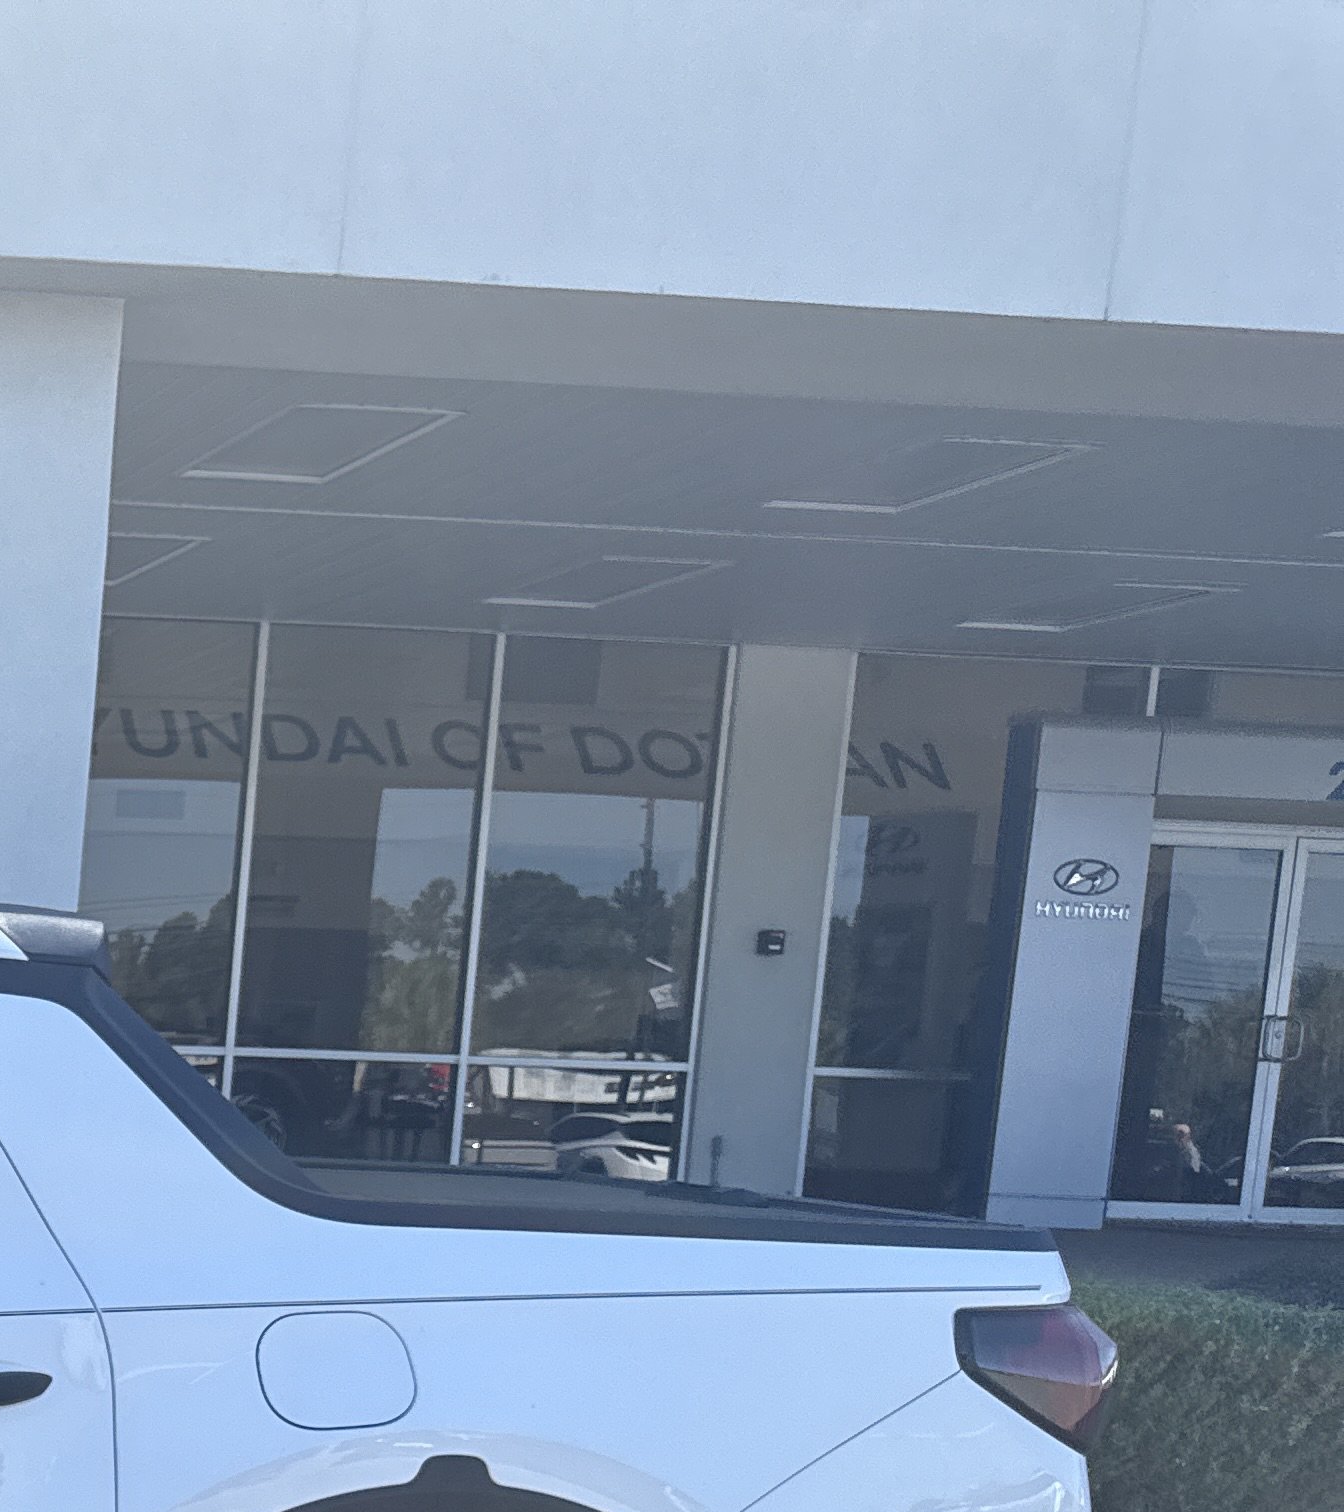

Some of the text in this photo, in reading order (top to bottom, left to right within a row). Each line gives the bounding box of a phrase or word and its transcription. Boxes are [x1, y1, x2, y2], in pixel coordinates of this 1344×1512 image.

[93, 706, 952, 791] UNDAI OF DOAN
[1036, 901, 1131, 920] HYUNDAI
